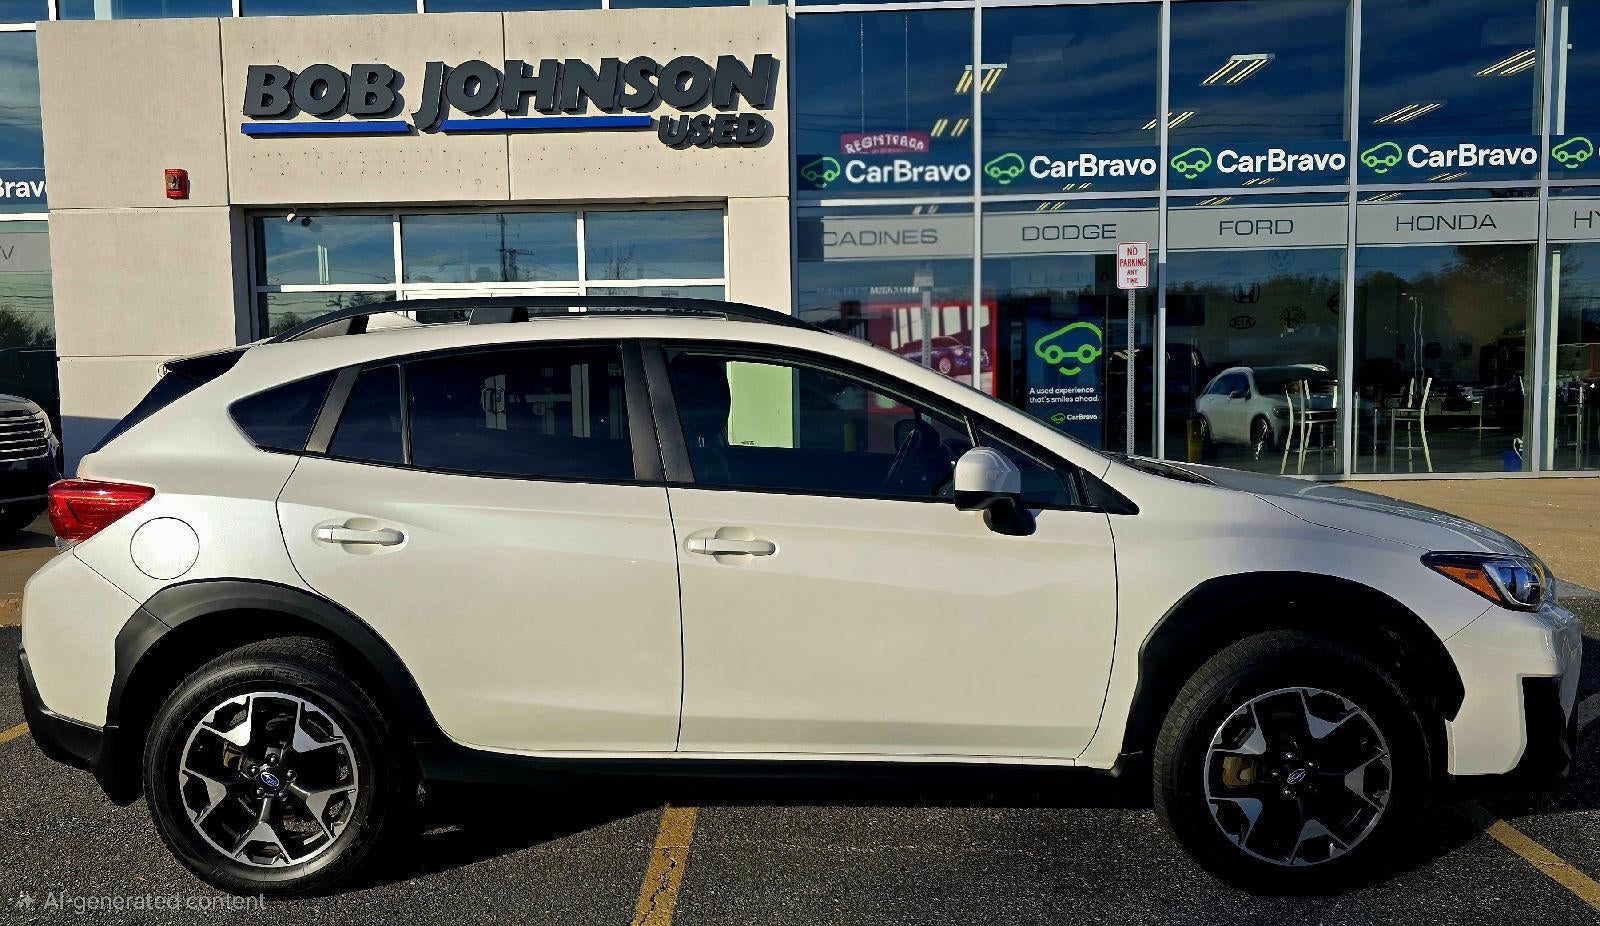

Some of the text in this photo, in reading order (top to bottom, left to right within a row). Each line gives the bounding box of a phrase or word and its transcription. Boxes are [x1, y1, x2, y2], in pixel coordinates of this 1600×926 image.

[242, 53, 776, 133] BOB JOHNSON
[658, 113, 771, 147] USED
[1029, 153, 1157, 179] CarBravo
[1216, 148, 1346, 173] CarBravo
[1407, 143, 1538, 169] CarBravo
[845, 159, 971, 184] CarBravo
[1022, 223, 1117, 241] DODGE
[1219, 218, 1294, 236] FORD
[1395, 213, 1497, 232] HONDA
[1119, 257, 1147, 267] PARKING
[1127, 247, 1138, 256] NO
[1029, 387, 1036, 395] A
[1055, 387, 1094, 395] experience
